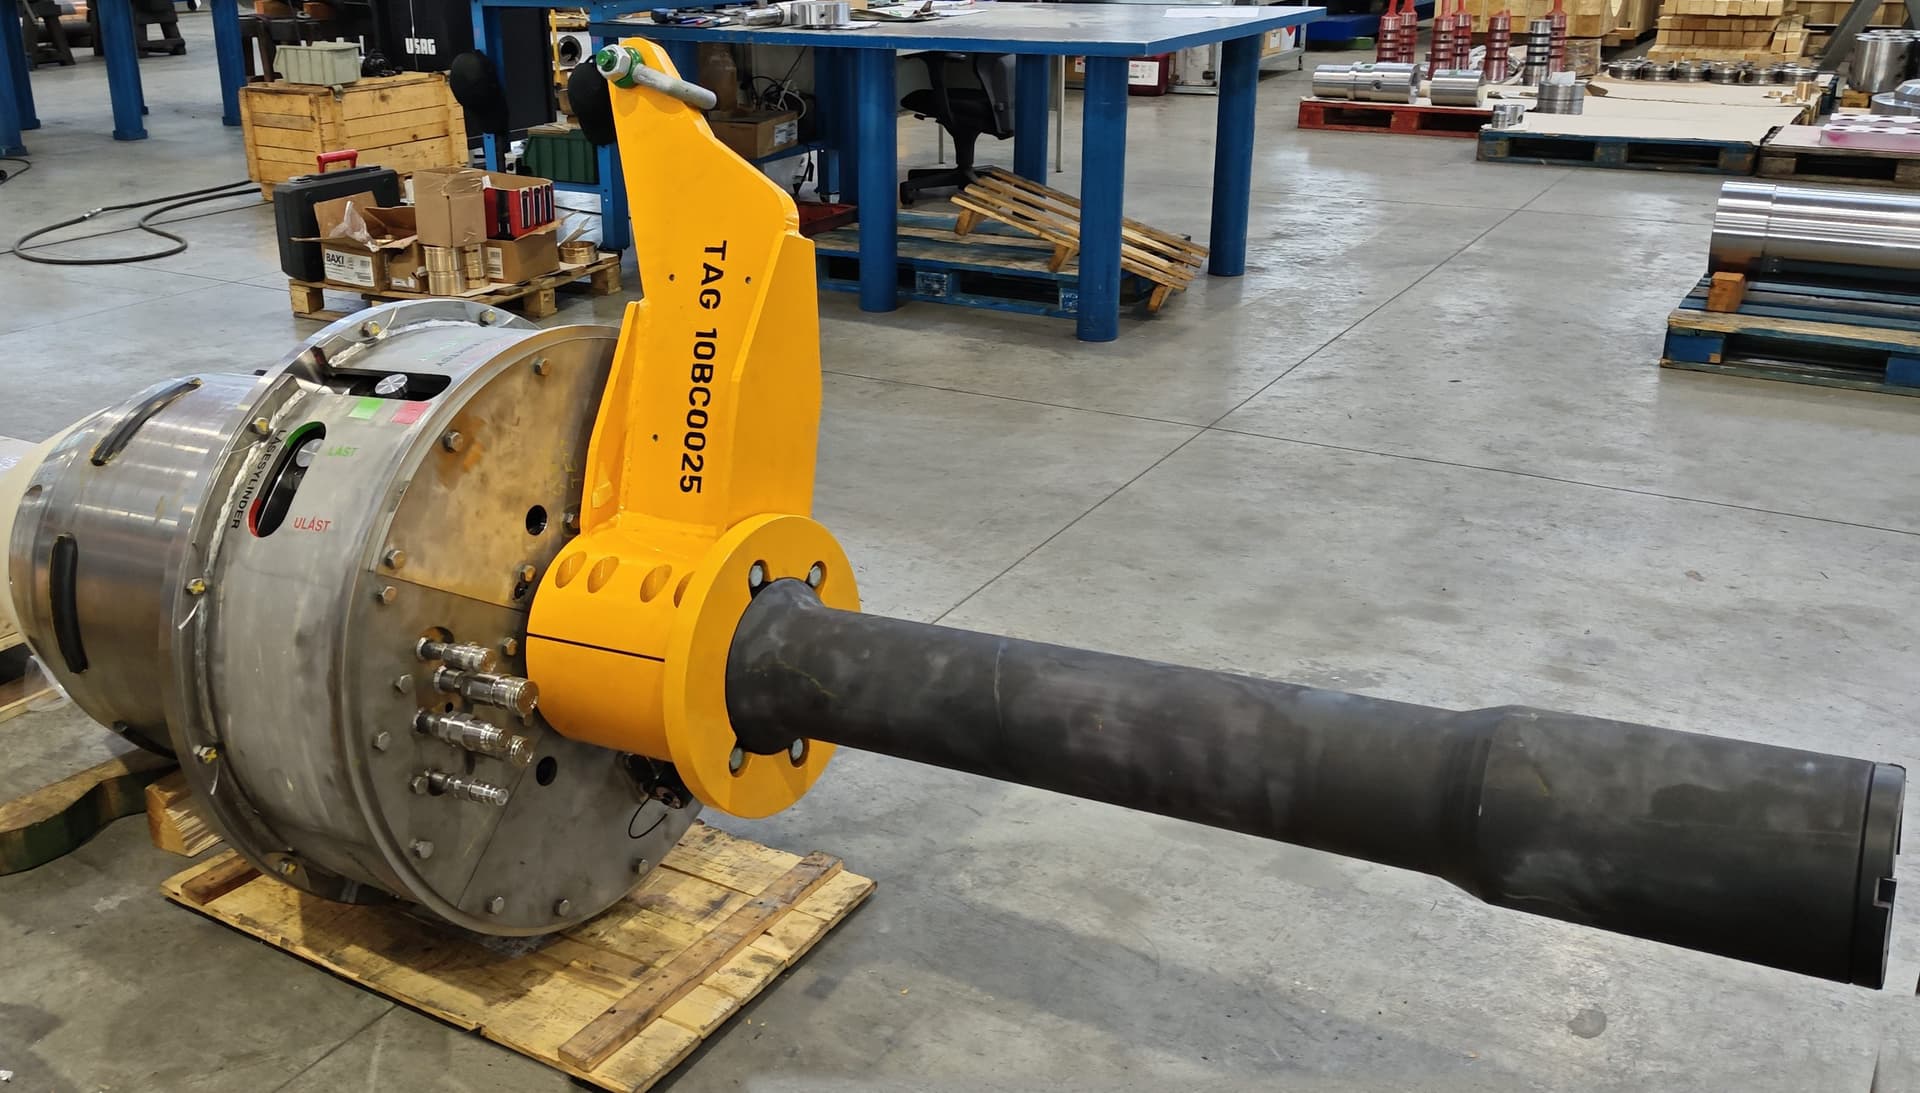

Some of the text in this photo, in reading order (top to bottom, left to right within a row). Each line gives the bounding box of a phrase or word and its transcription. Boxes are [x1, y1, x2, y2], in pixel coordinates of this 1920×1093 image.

[405, 37, 436, 55] USAG
[325, 252, 345, 265] BAXI
[679, 240, 728, 494] TAG 10BC0025
